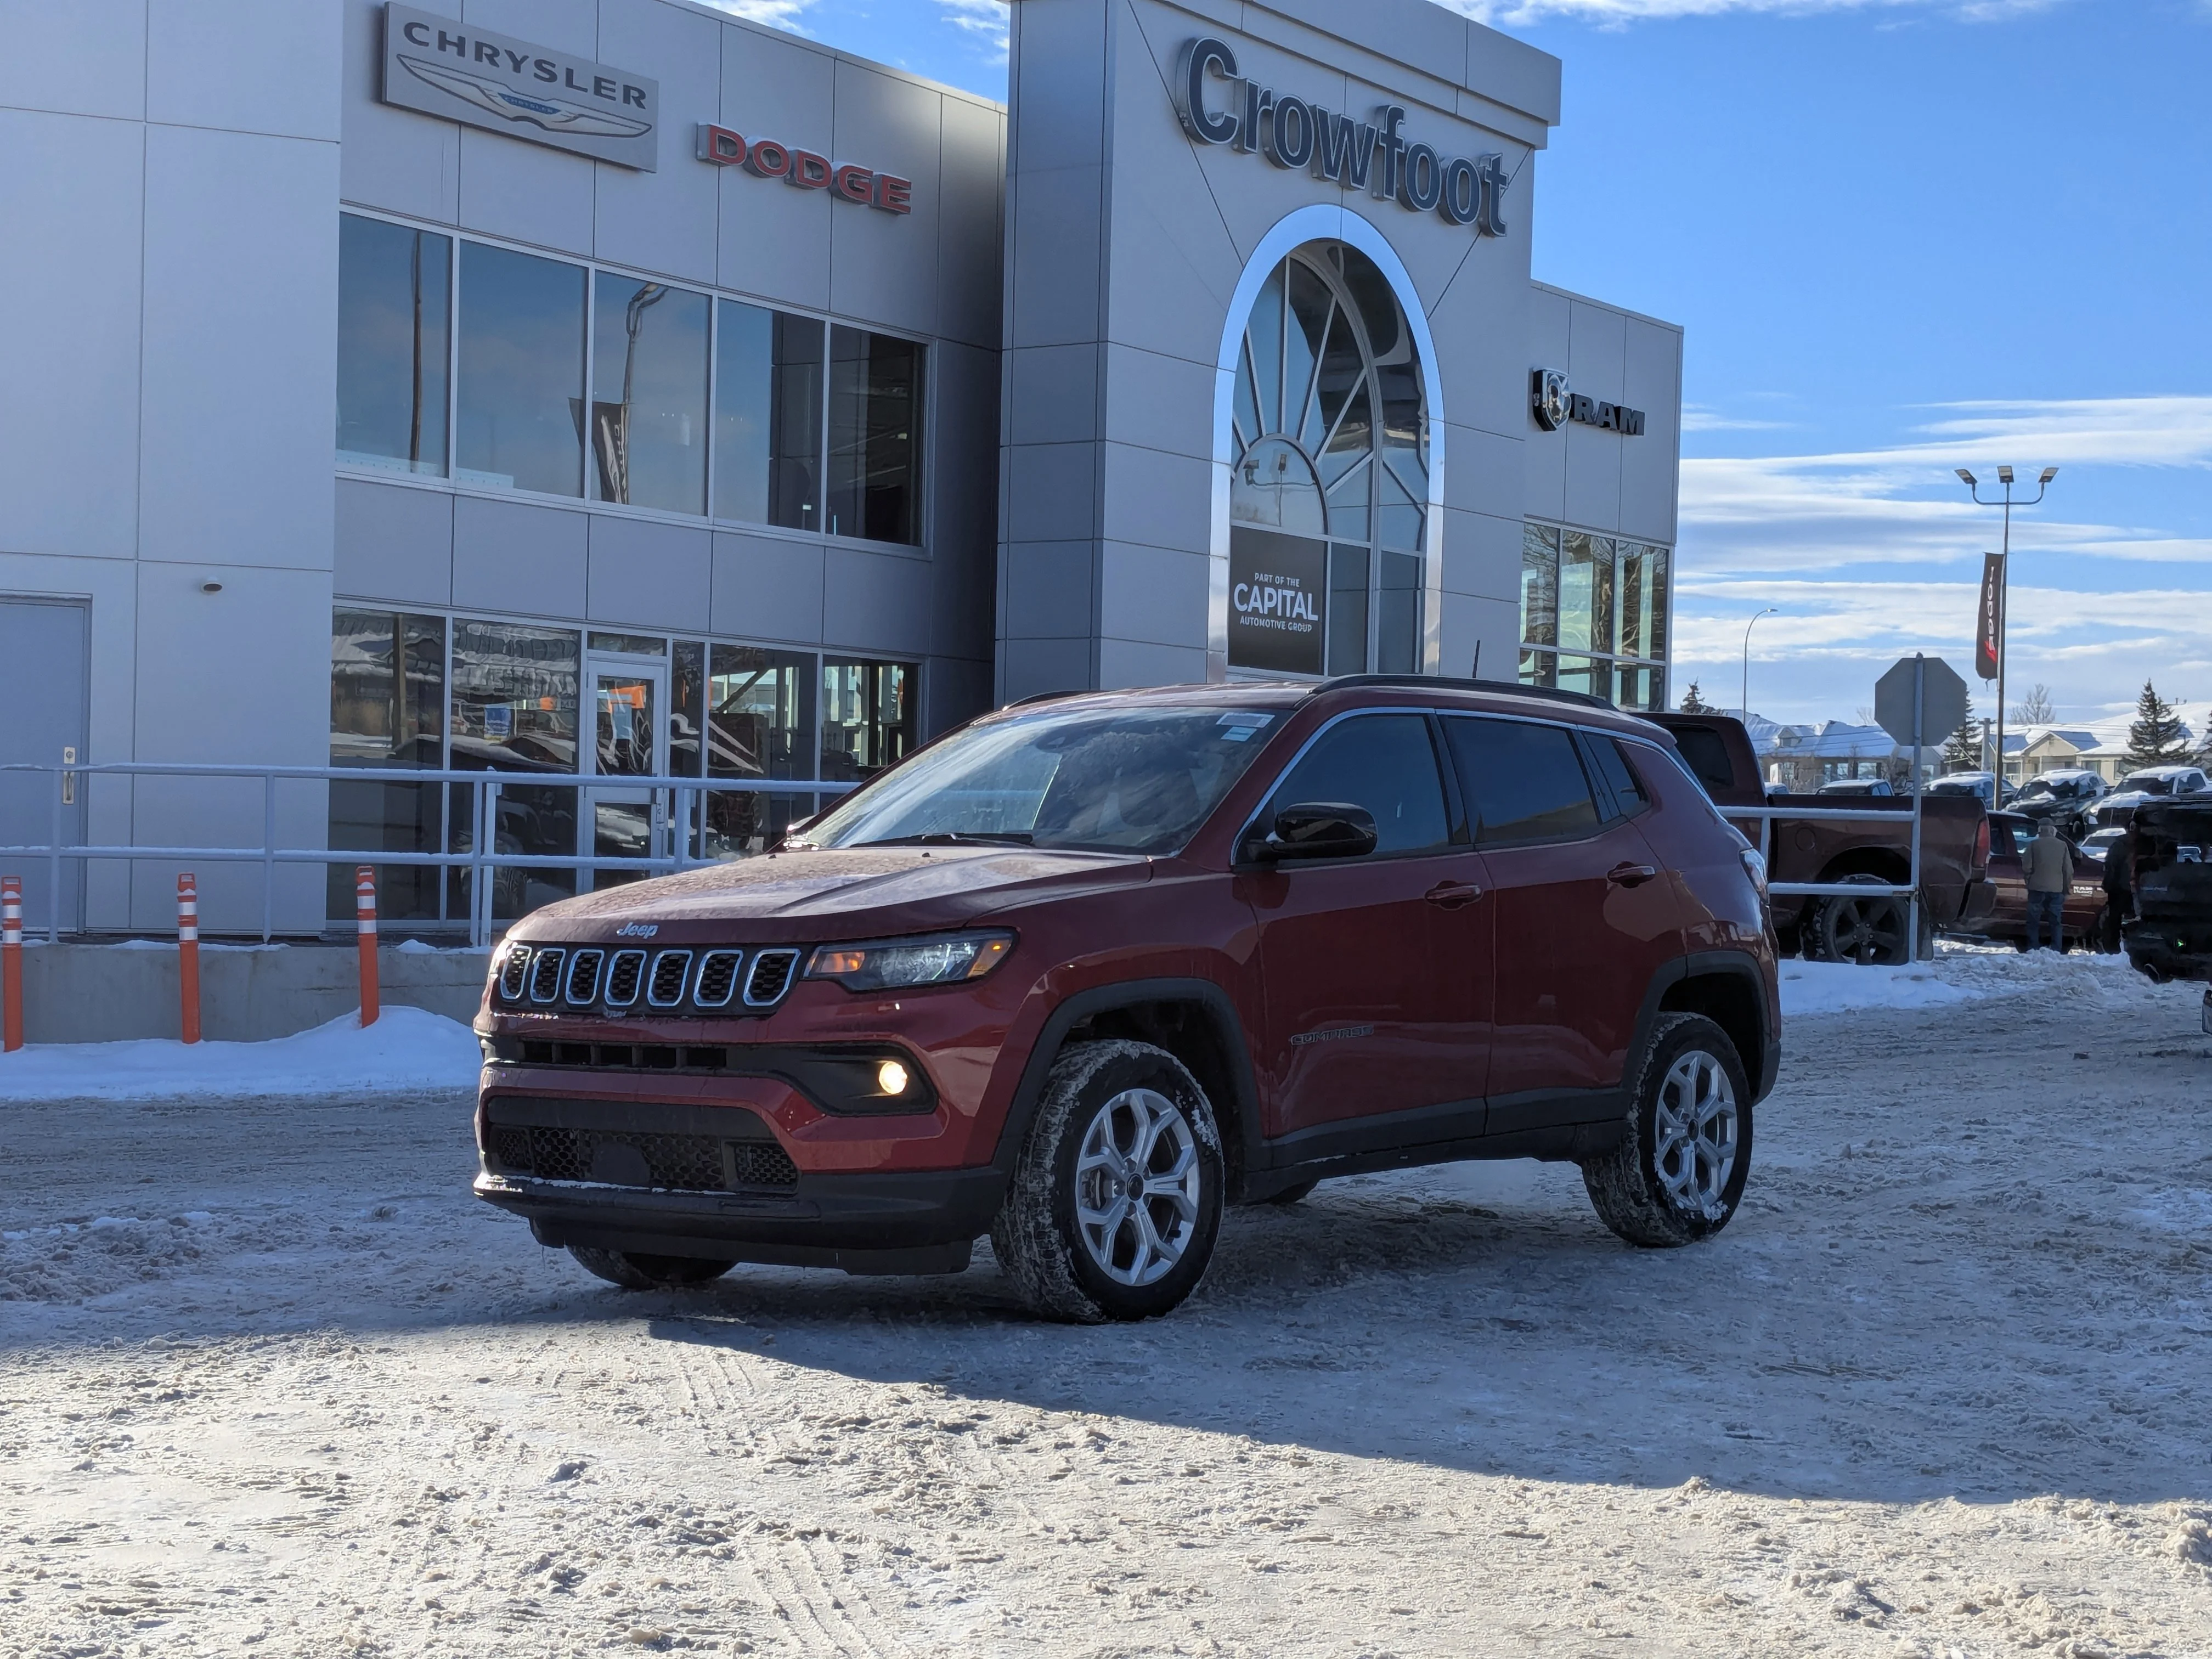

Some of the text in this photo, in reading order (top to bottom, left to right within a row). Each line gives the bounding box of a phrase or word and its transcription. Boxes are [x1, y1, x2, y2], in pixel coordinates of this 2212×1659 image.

[403, 22, 646, 110] CHRYSLER
[1185, 36, 1509, 237] Crowfoot
[708, 123, 912, 215] DODGE
[1573, 393, 1645, 436] RAM
[1255, 572, 1300, 587] PART OF THE
[1234, 583, 1318, 621] CAPITAL
[1240, 616, 1312, 633] AUTOMOTIVE GROUP
[617, 922, 658, 939] Jeep
